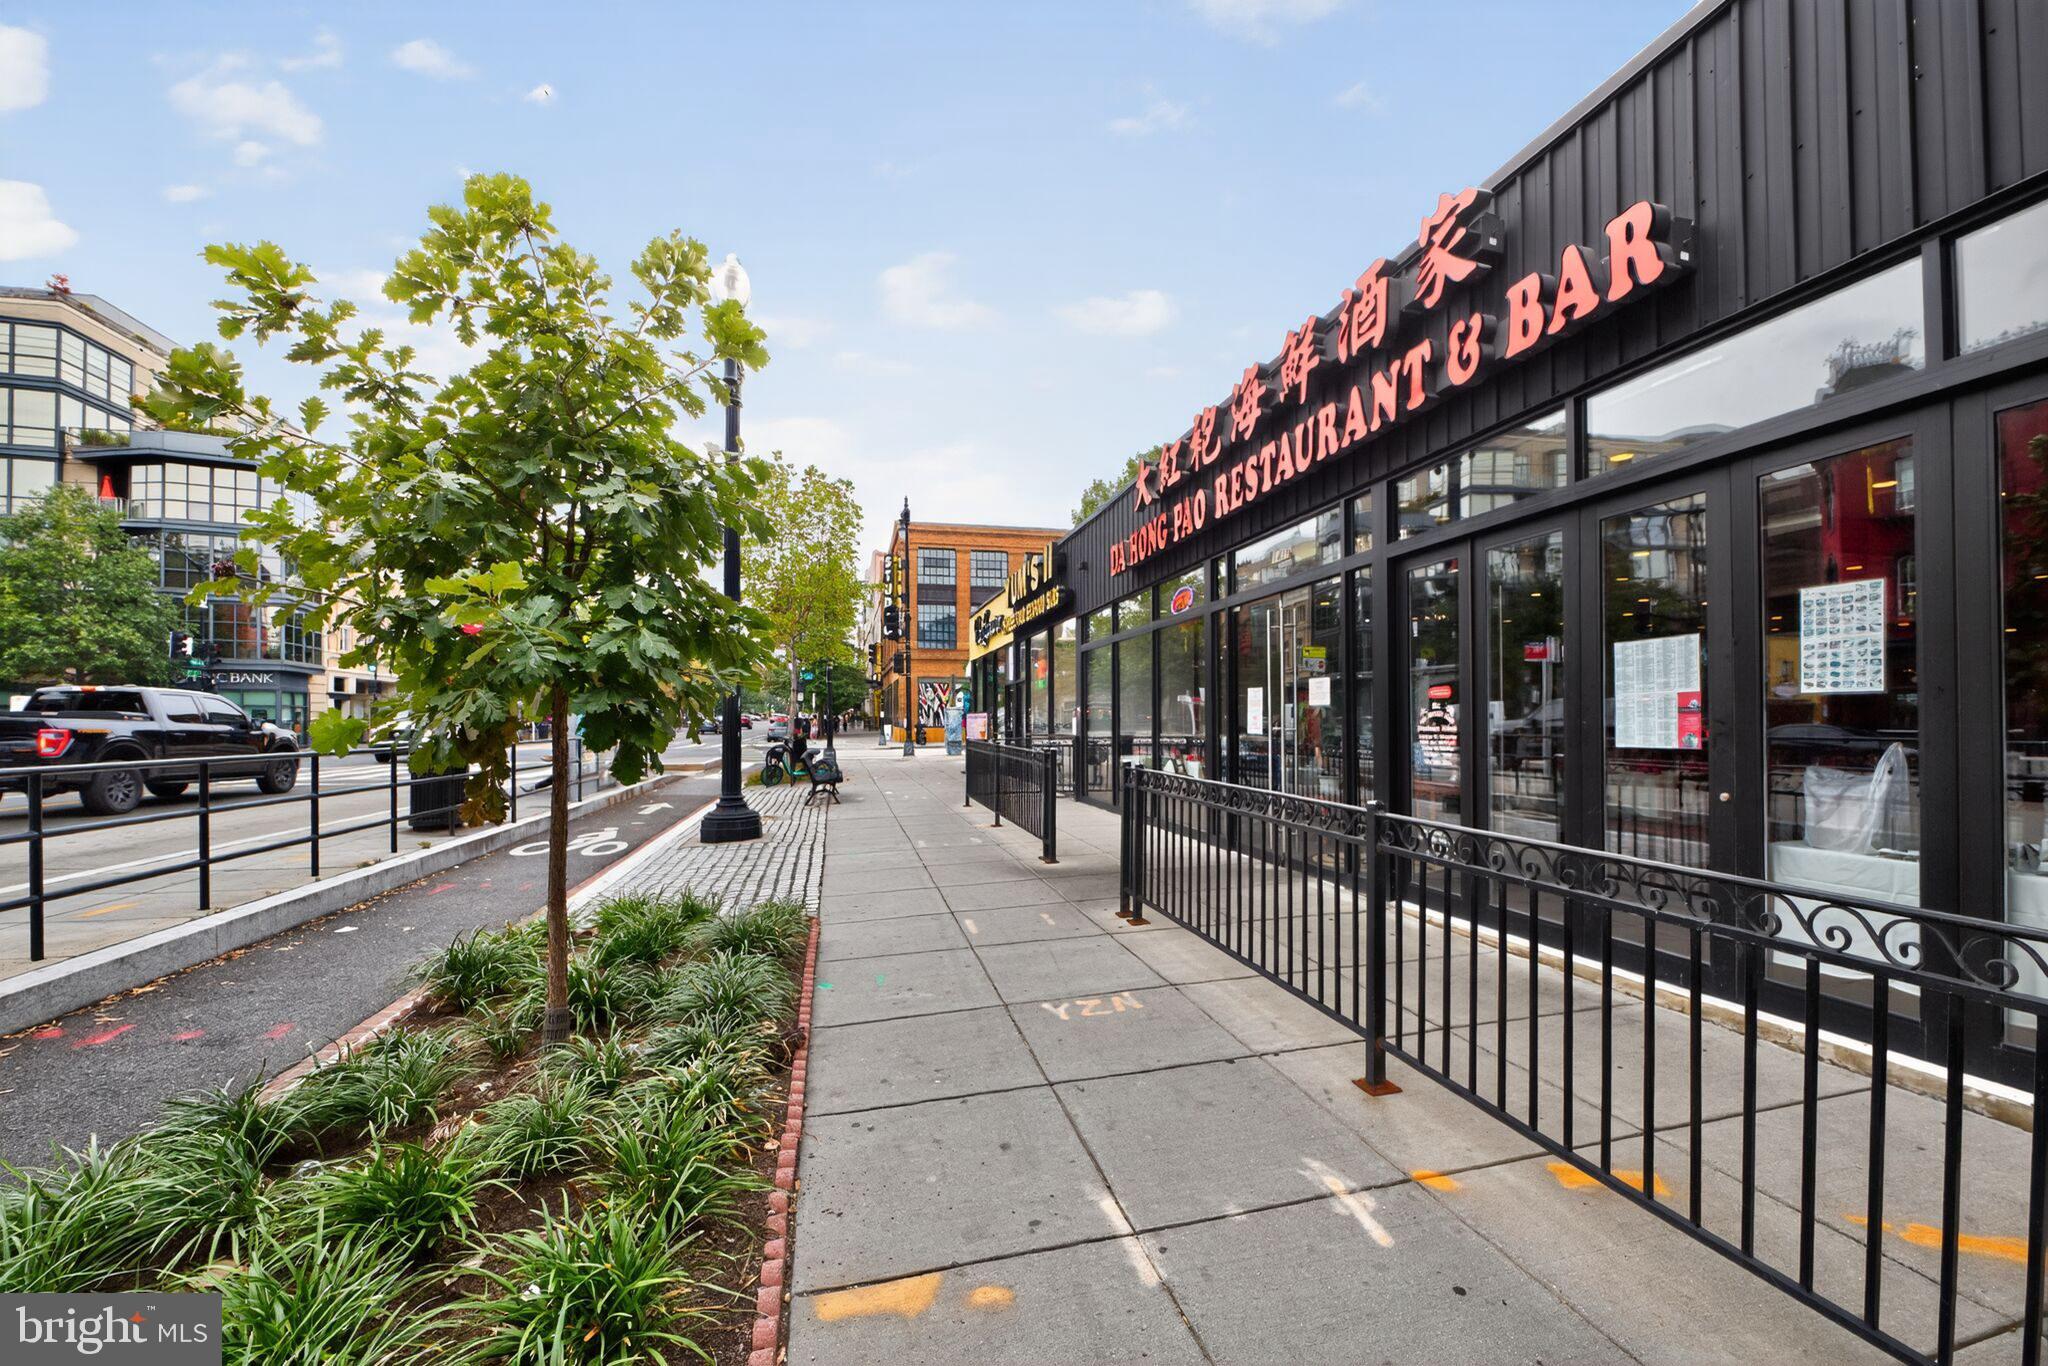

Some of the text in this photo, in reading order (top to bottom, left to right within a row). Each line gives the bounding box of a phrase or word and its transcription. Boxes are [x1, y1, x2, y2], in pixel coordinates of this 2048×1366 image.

[1111, 202, 1665, 577] DA HONG PAO RESTAURANT & BAR
[230, 673, 273, 684] BANK
